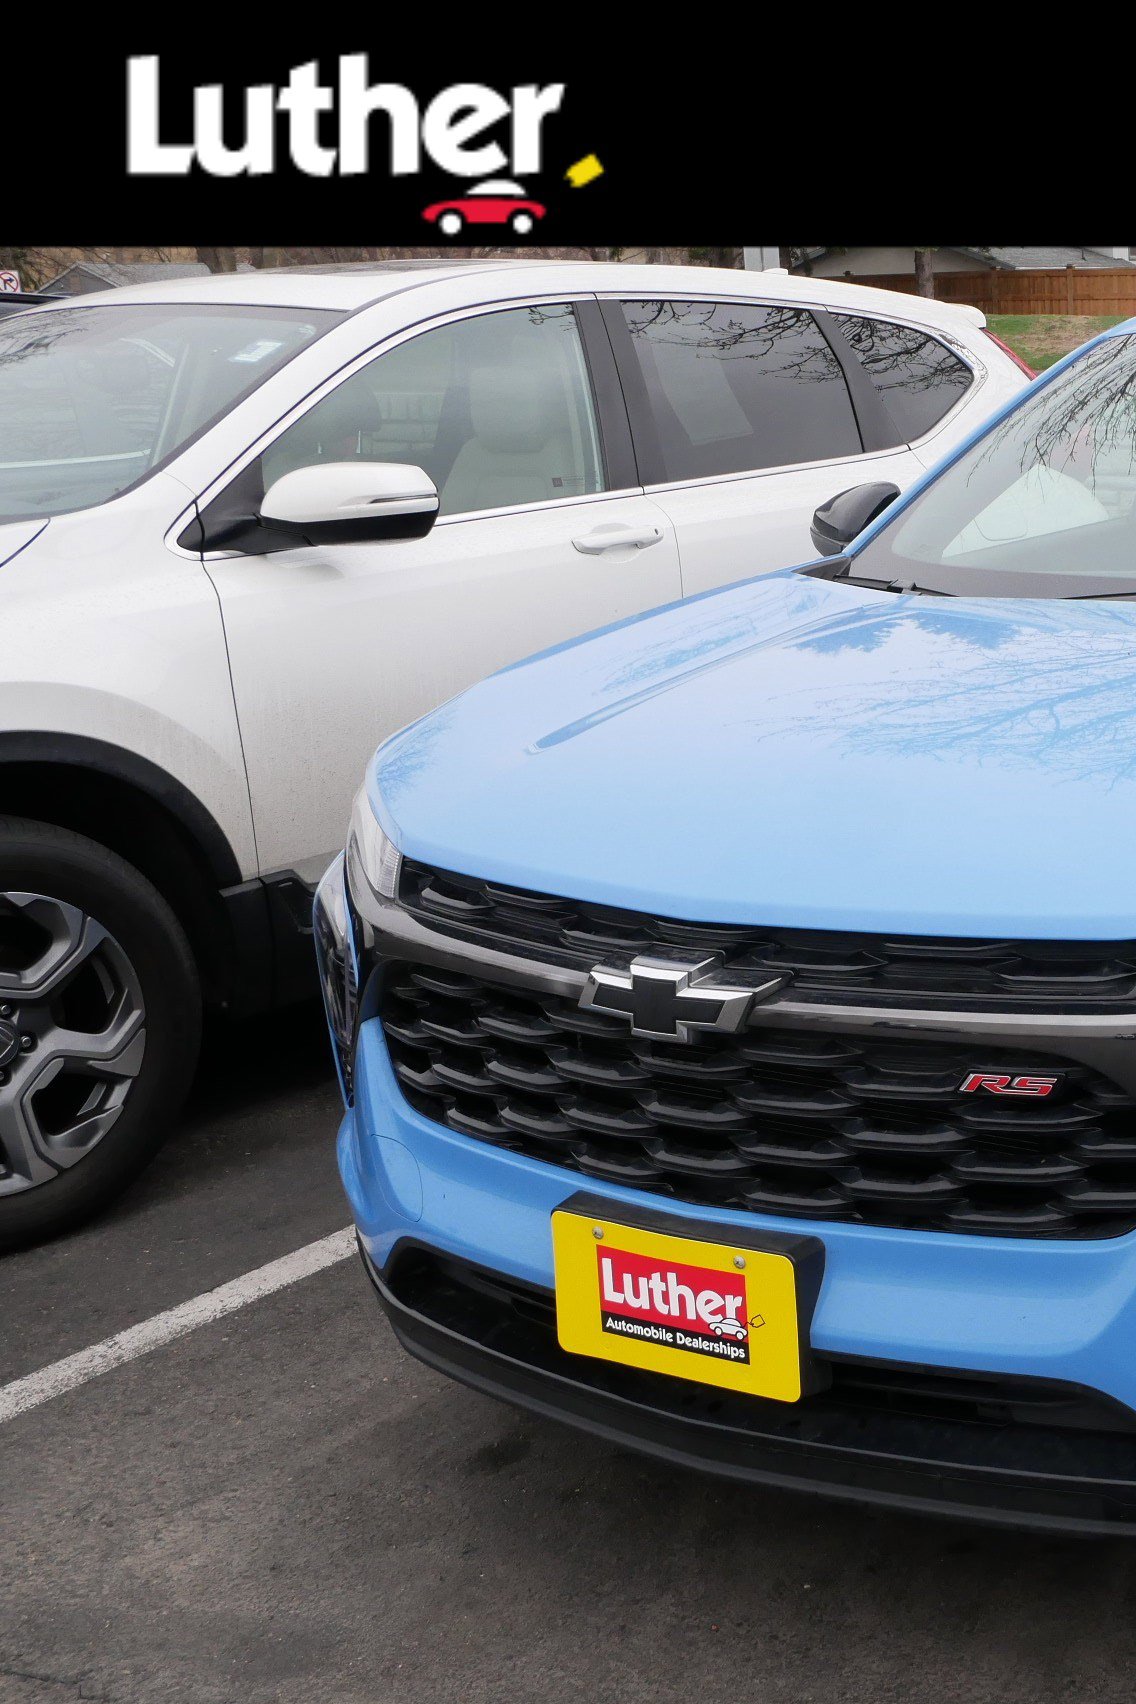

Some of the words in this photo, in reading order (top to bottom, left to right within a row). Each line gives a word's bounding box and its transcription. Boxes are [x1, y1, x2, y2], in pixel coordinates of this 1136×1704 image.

[959, 1073, 1058, 1097] RS
[601, 1257, 743, 1324] Luther
[605, 1317, 673, 1343] Automobile
[676, 1332, 746, 1360] Dealerships
